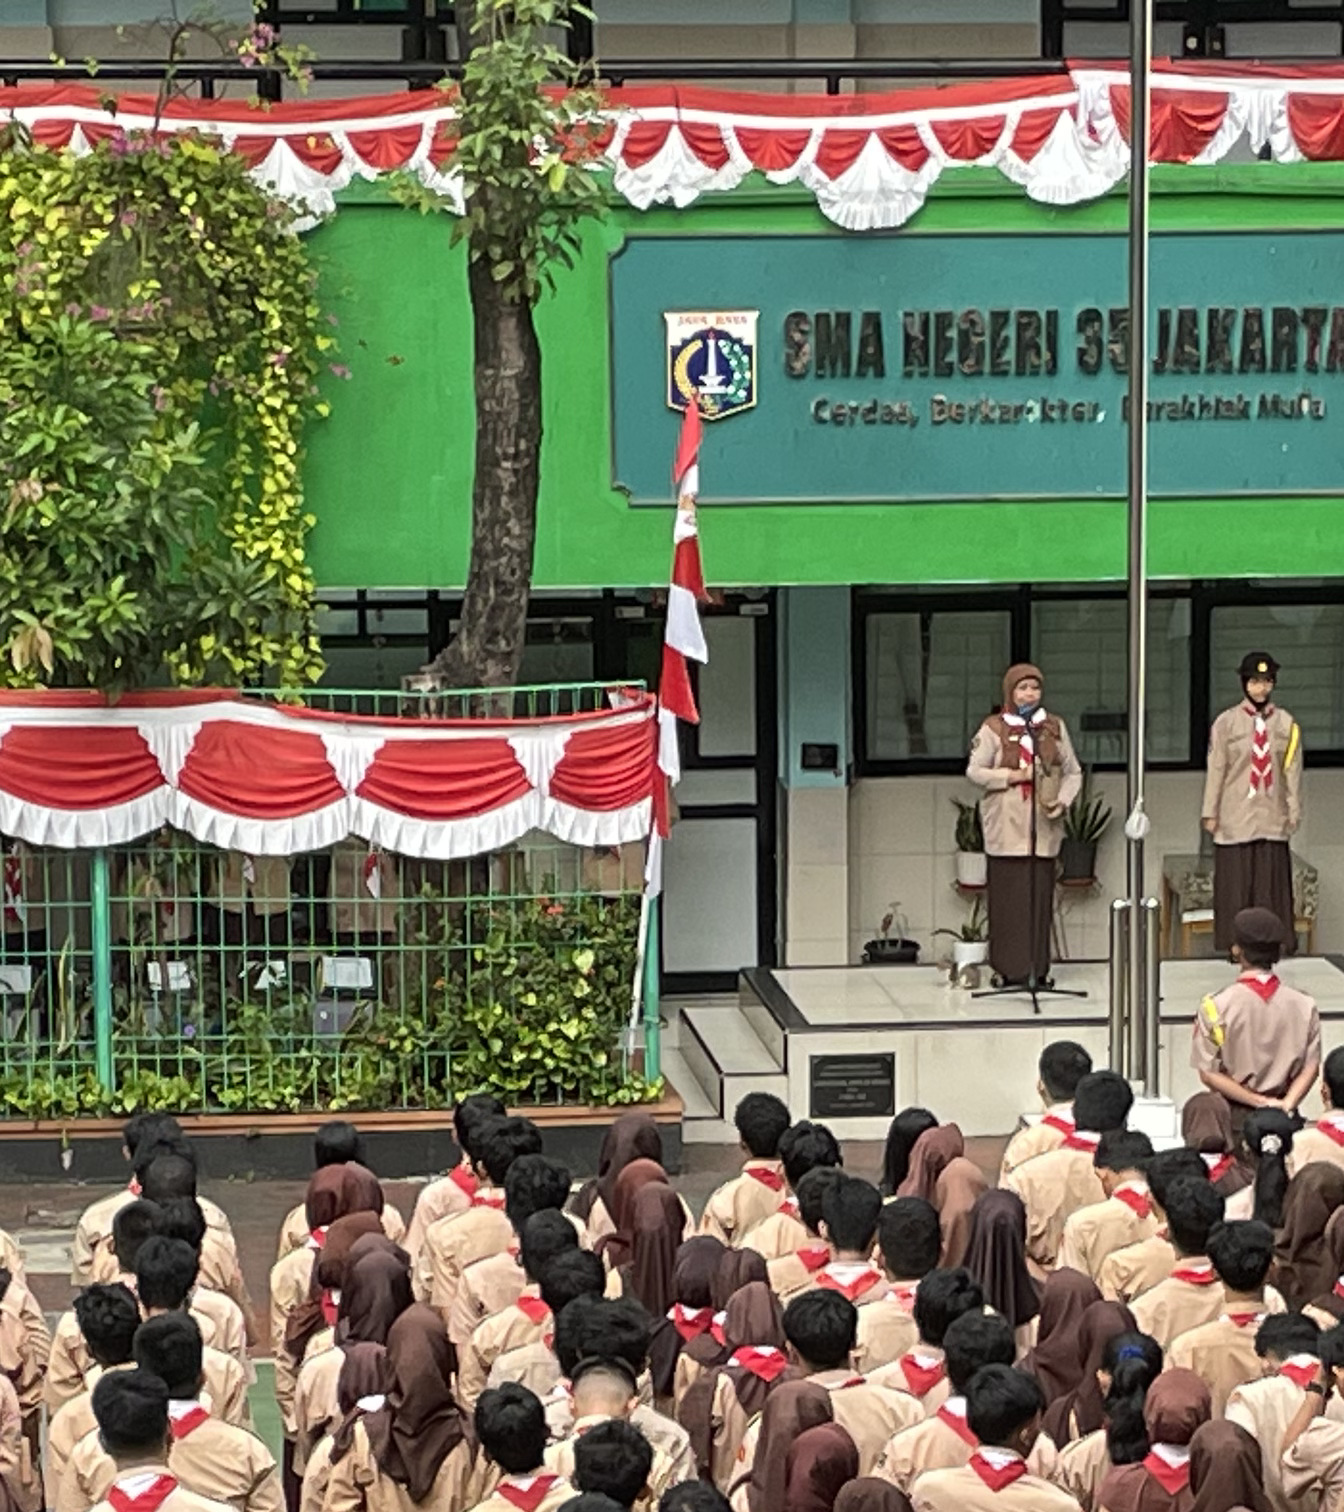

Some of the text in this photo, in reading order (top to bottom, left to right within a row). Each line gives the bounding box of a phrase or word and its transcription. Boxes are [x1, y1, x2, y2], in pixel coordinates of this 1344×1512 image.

[783, 310, 886, 379] SMA
[902, 308, 1059, 379] NEGERI
[1075, 307, 1130, 376] 35
